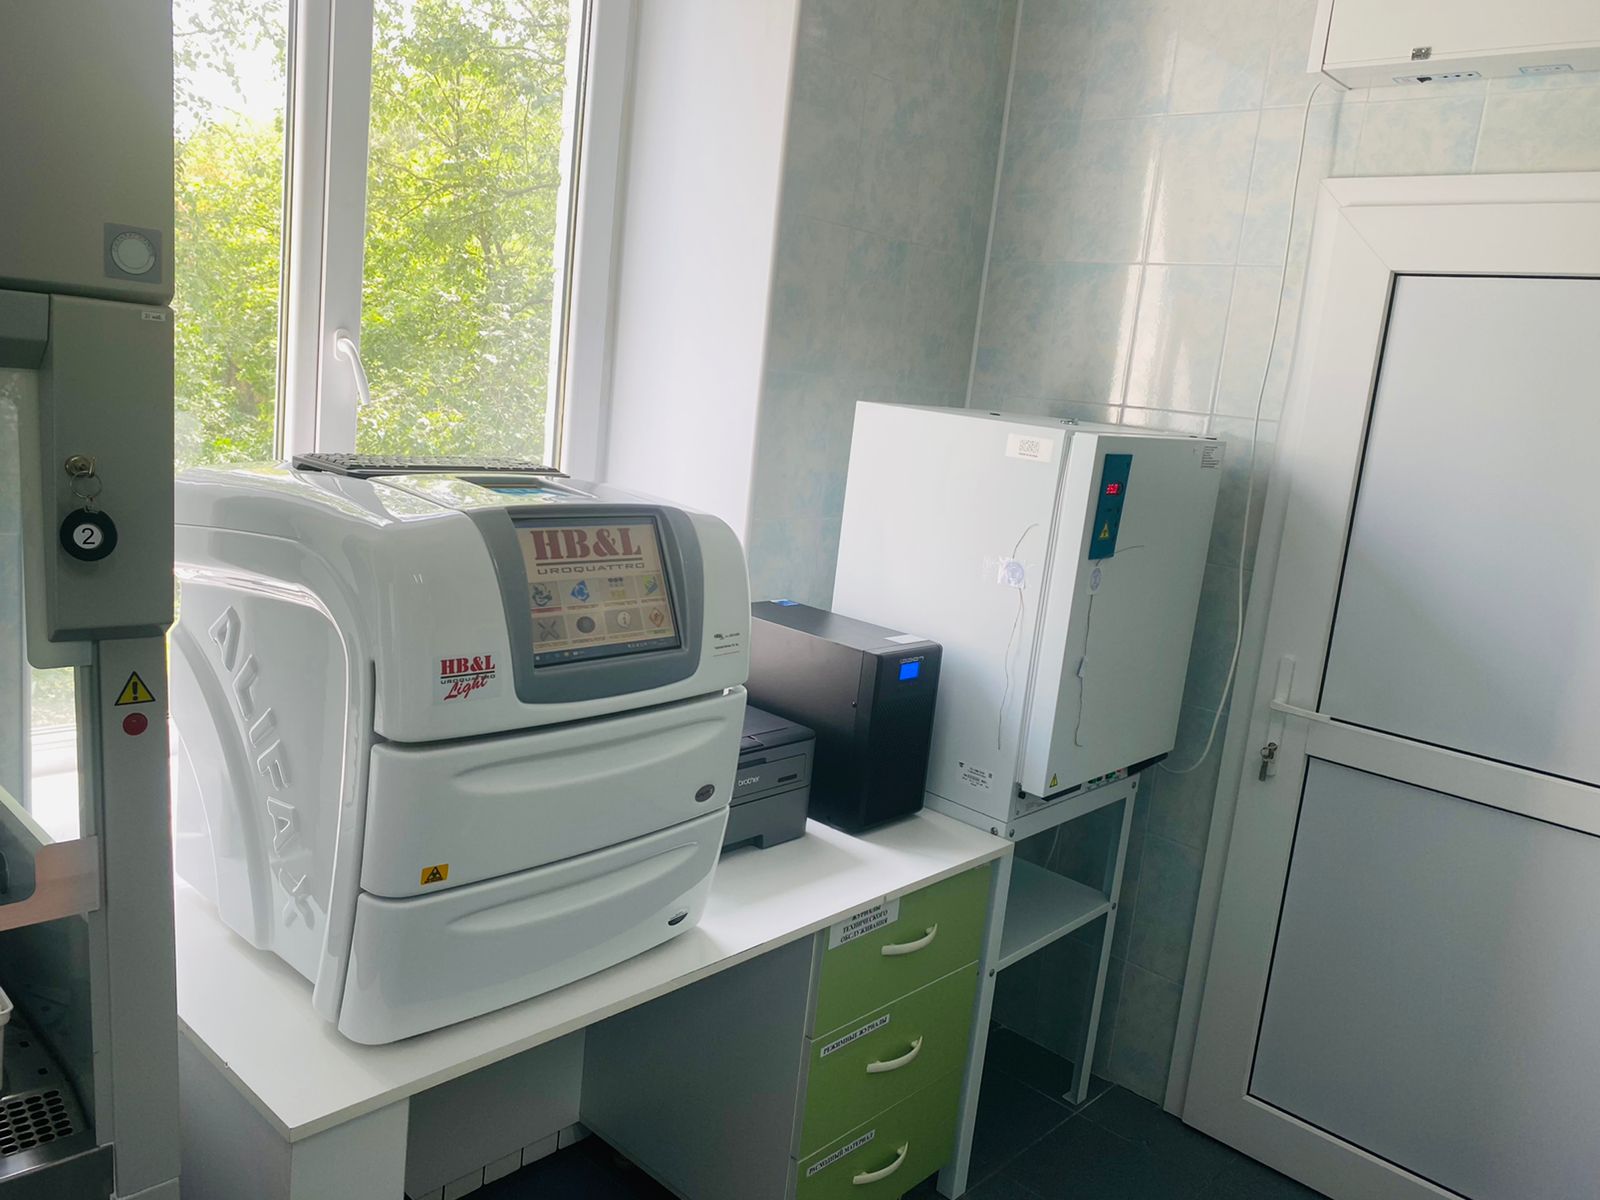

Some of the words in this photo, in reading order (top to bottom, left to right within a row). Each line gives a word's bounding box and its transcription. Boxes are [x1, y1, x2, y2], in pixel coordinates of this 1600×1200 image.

[81, 527, 96, 545] 2
[530, 527, 642, 560] HB&L
[537, 562, 645, 575] UROQUATTRO
[441, 655, 496, 675] HB&L
[443, 675, 488, 701] Light
[738, 776, 760, 787] brother
